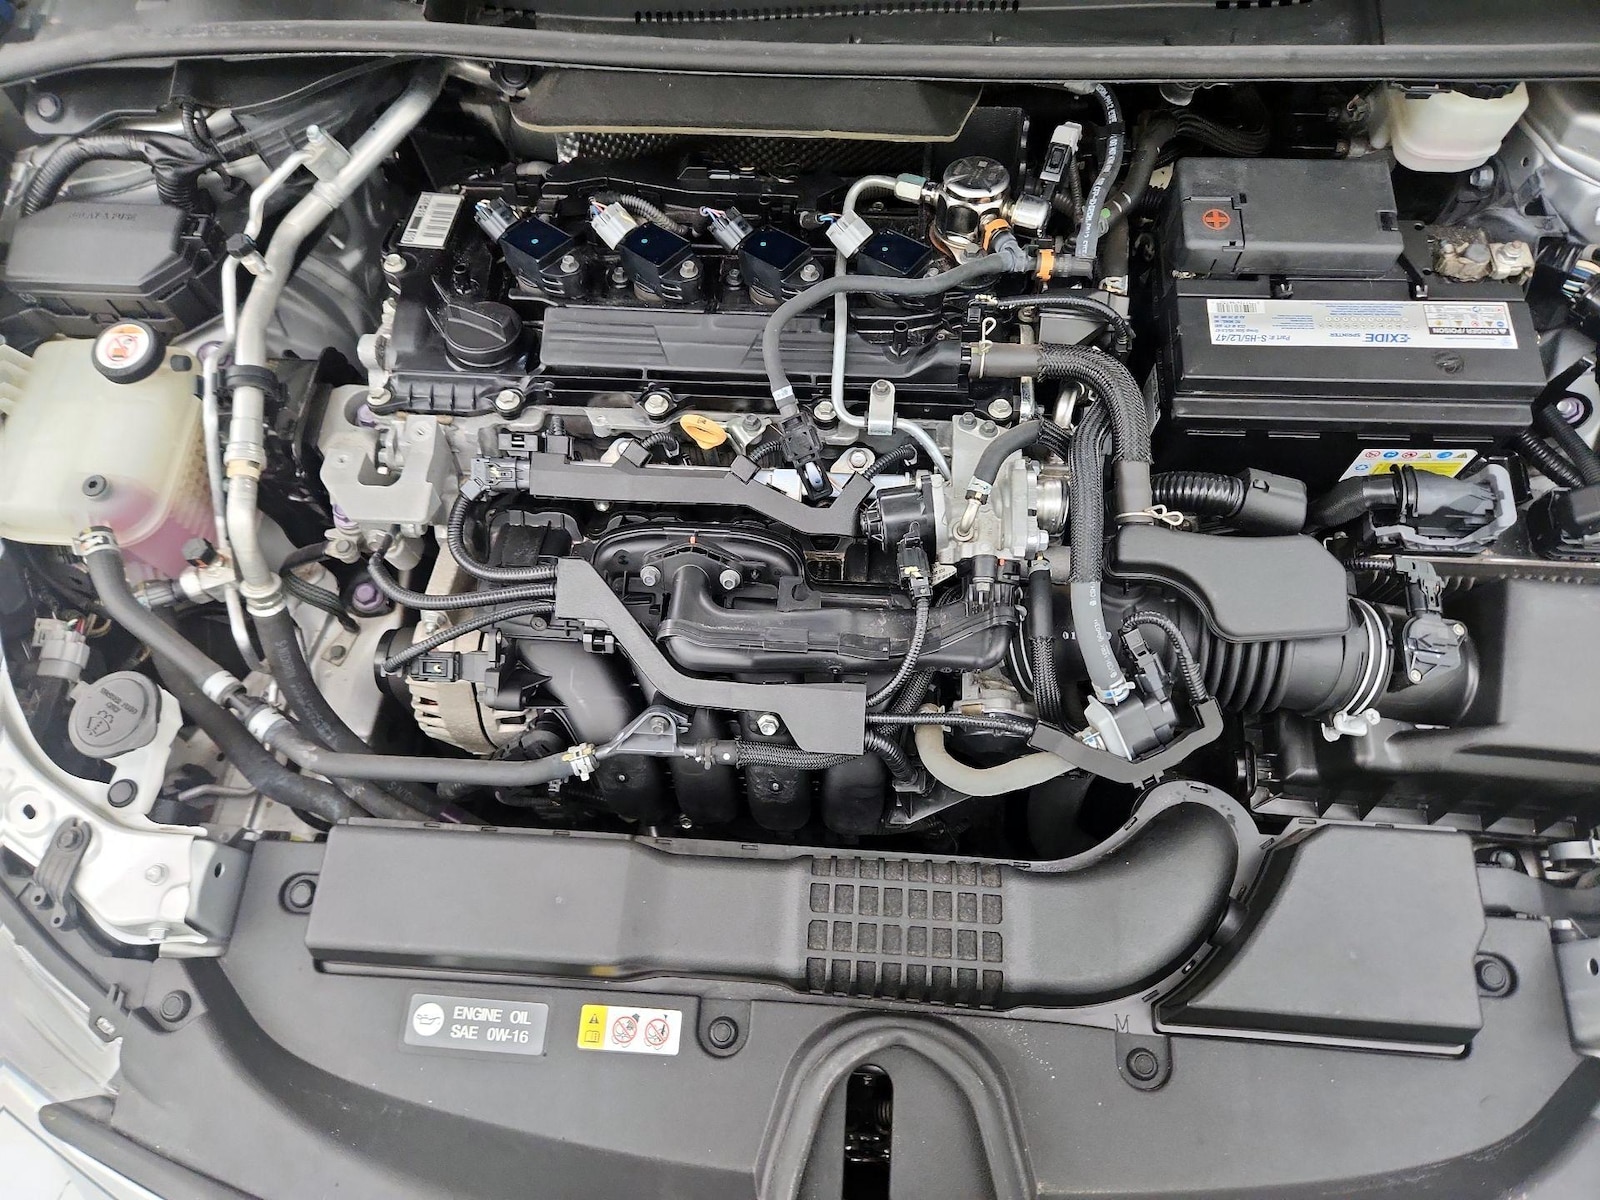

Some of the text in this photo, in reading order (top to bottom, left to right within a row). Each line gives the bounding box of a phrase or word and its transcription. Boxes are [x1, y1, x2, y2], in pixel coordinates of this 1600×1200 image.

[1365, 333, 1411, 343] EXIDE
[453, 1006, 532, 1025] ENGINE OIL
[450, 1024, 529, 1043] SAE 0W-16
